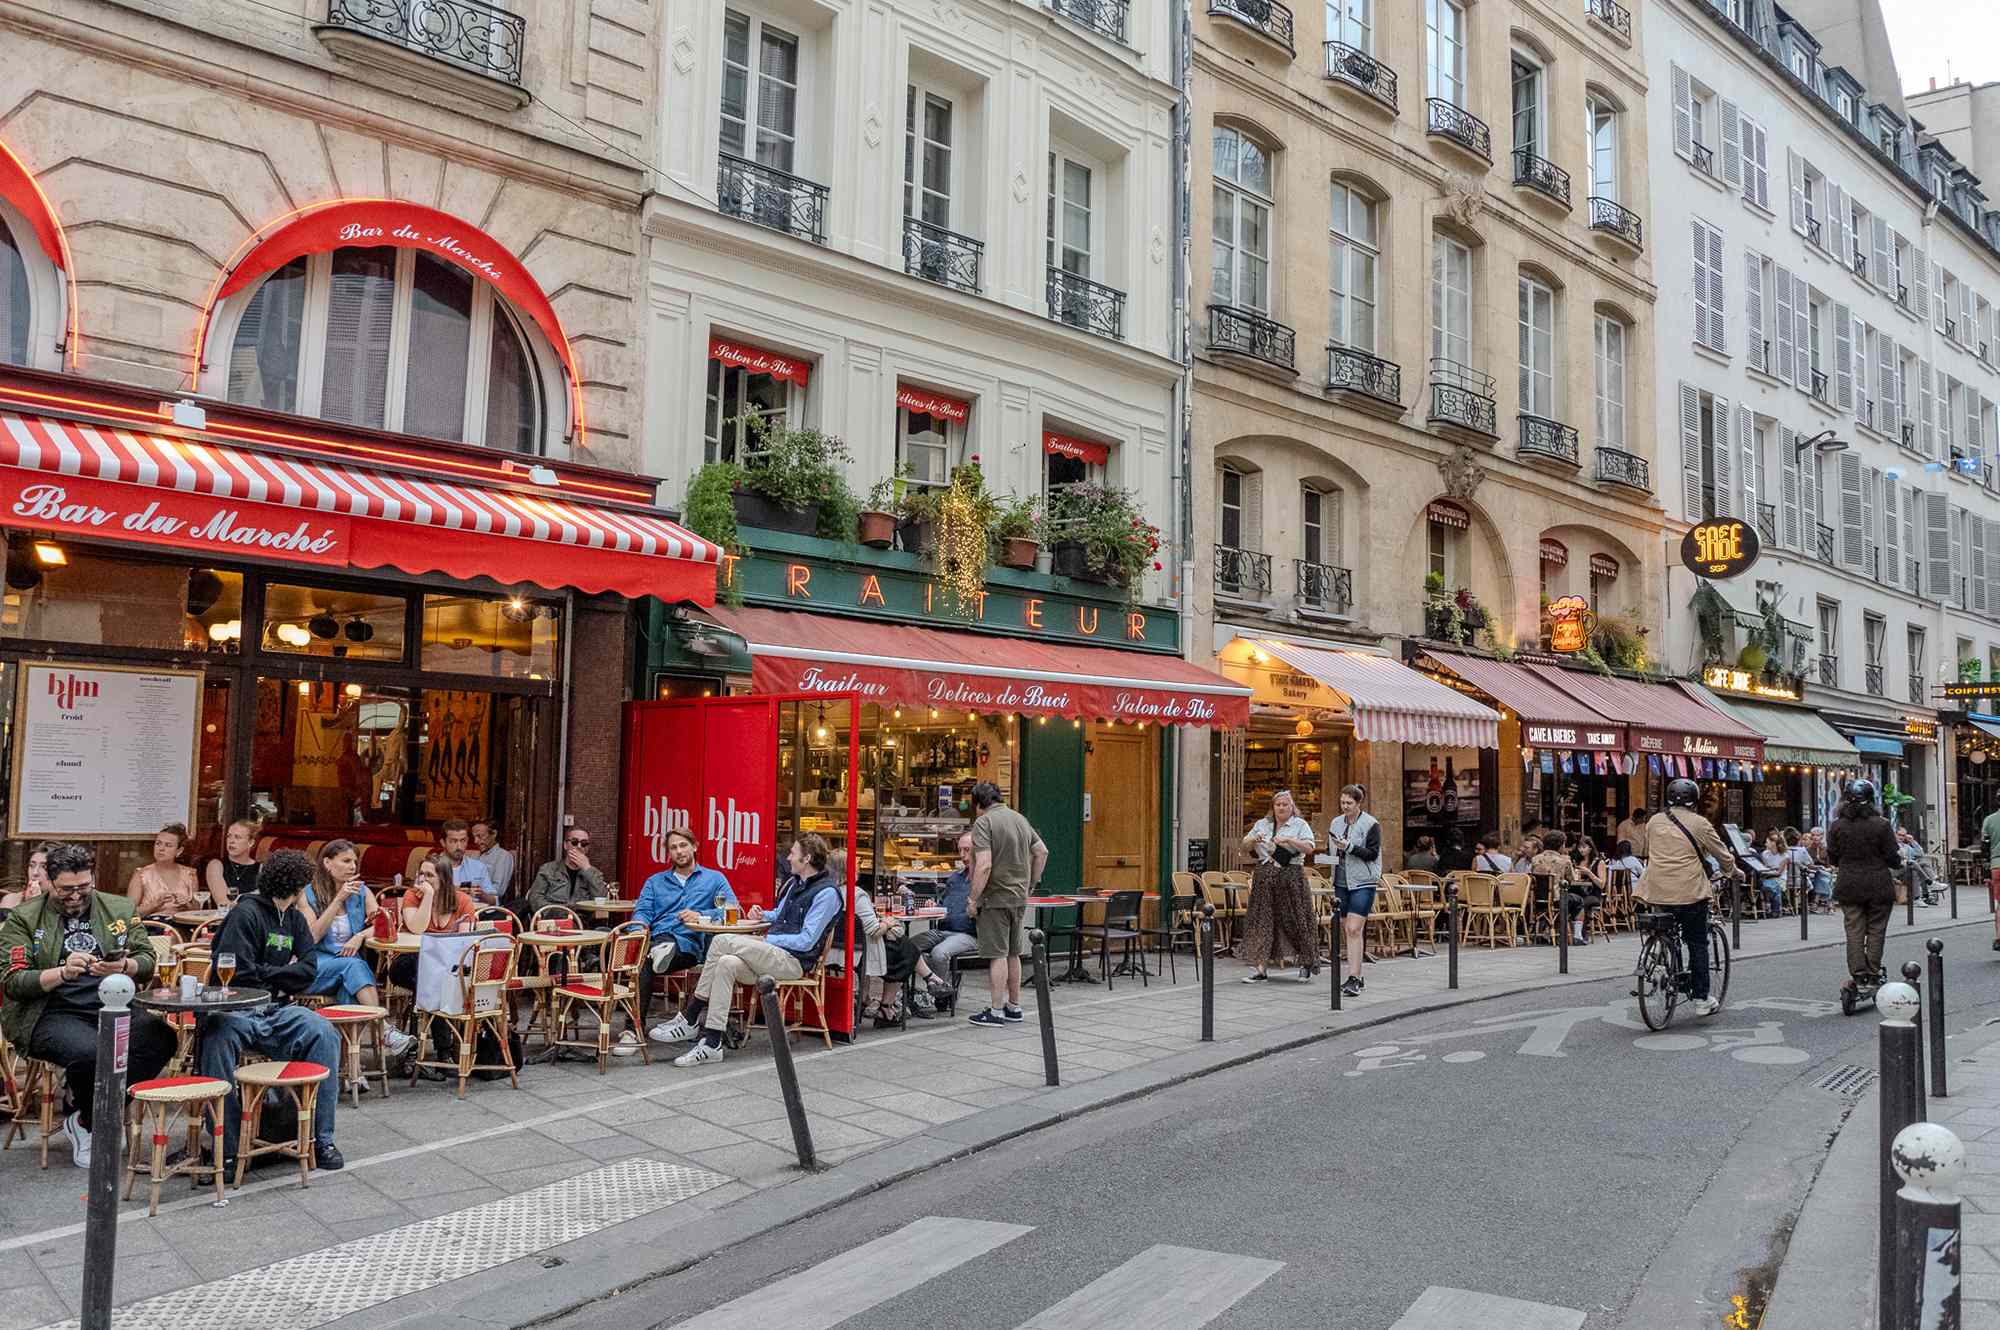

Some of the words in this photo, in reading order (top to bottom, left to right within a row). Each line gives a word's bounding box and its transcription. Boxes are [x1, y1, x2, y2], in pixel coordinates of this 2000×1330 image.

[339, 223, 385, 240] Bar
[392, 224, 420, 240] du
[427, 236, 503, 280] Marché
[715, 344, 750, 365] Salon
[752, 356, 769, 368] de
[770, 359, 793, 375] Thé
[926, 400, 940, 411] de
[940, 402, 964, 417] Buci
[1048, 437, 1085, 455] Traiteur
[12, 484, 117, 526] Bar
[123, 502, 188, 534] du
[190, 510, 337, 554] Marché
[723, 554, 1146, 641] TRAITEUR
[798, 667, 890, 696] Traiteur
[927, 677, 994, 705] Delices
[996, 687, 1021, 705] de
[1022, 685, 1071, 709] Buci
[1283, 688, 1307, 699] Bakery
[1112, 692, 1163, 715] Salon
[1163, 698, 1183, 717] de
[1185, 698, 1215, 719] Thé
[61, 713, 83, 721] froid
[1529, 727, 1547, 743] CAVE
[1552, 728, 1576, 744] BIERES
[1586, 732, 1600, 745] TAKE
[1601, 733, 1616, 745] AWAY
[56, 760, 82, 768] chaud
[51, 793, 82, 801] dessert
